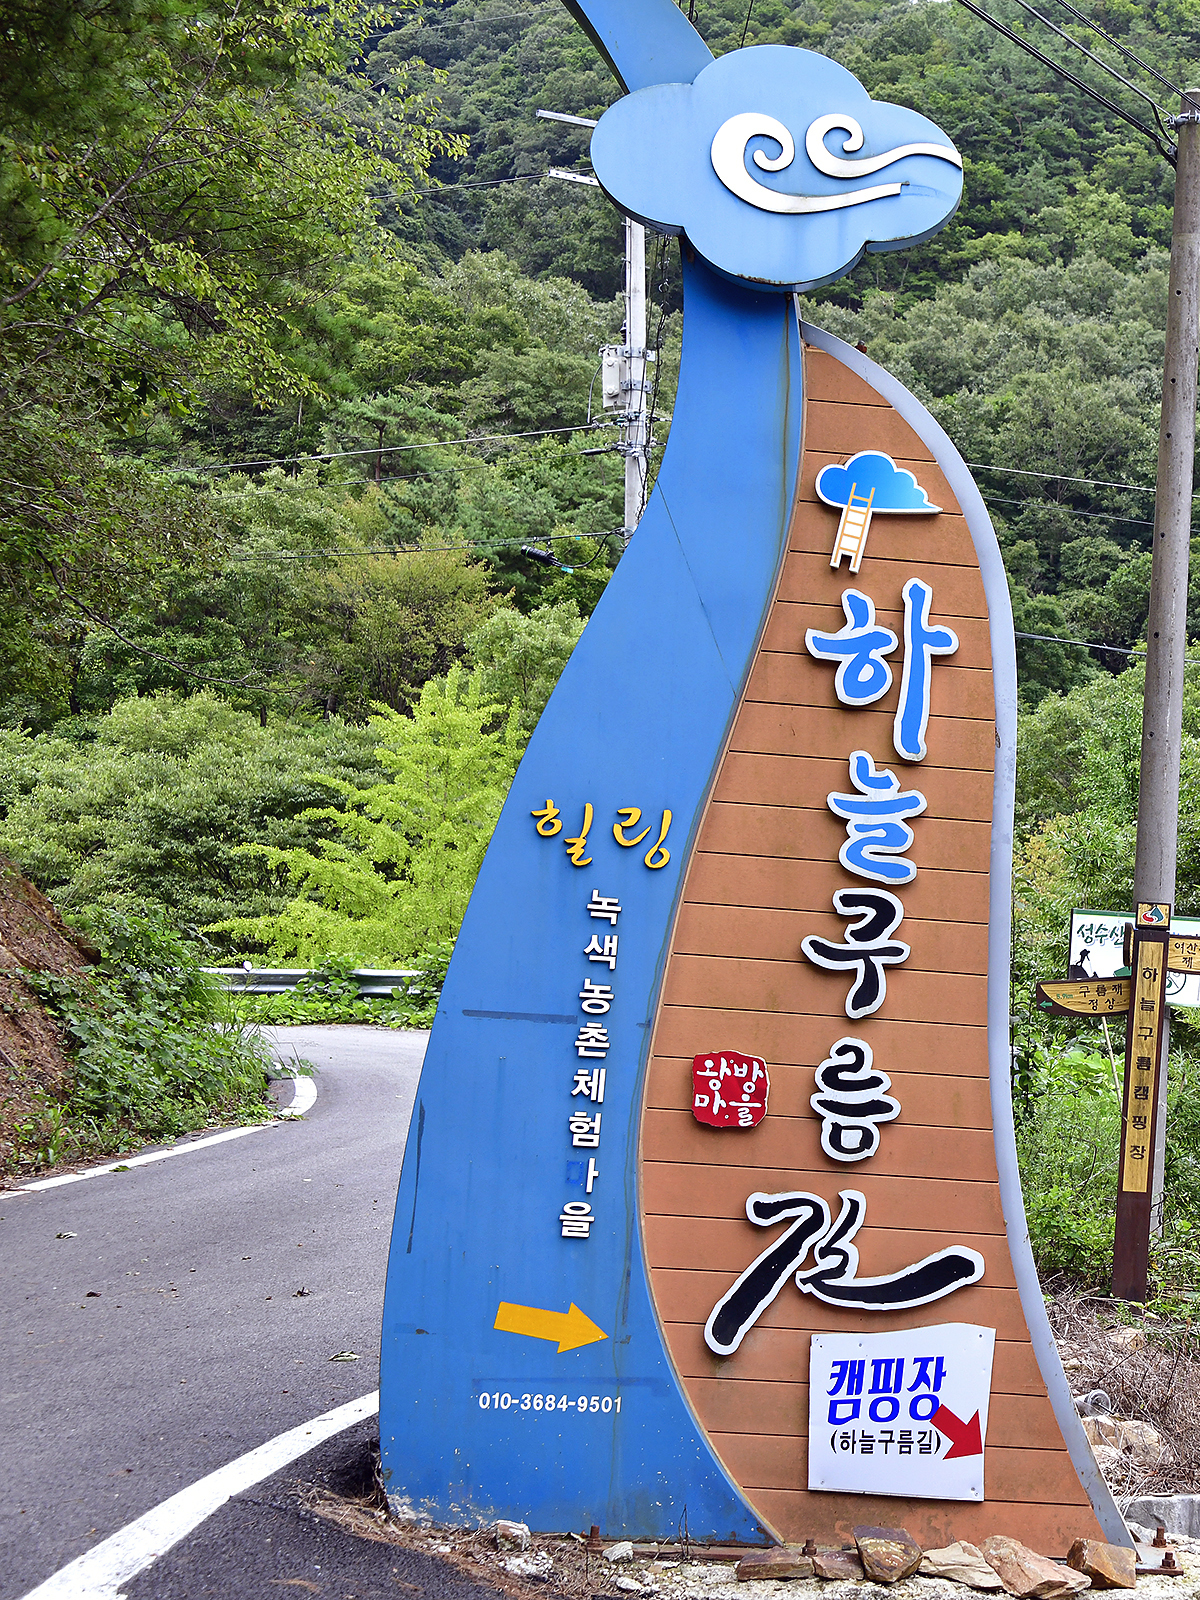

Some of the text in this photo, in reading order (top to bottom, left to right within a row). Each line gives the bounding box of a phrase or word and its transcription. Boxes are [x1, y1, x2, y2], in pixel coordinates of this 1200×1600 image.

[531, 798, 673, 870] 힐링
[1077, 923, 1126, 946] 성수산
[704, 577, 986, 1356] 하늘구름길
[1129, 966, 1159, 1160] 하늘구름캠핑장
[694, 1091, 763, 1127] 마을
[478, 1392, 623, 1414] 010-3684-9501
[826, 1355, 947, 1426] 캠핑장
[830, 1429, 942, 1455] (하늘구름길)
